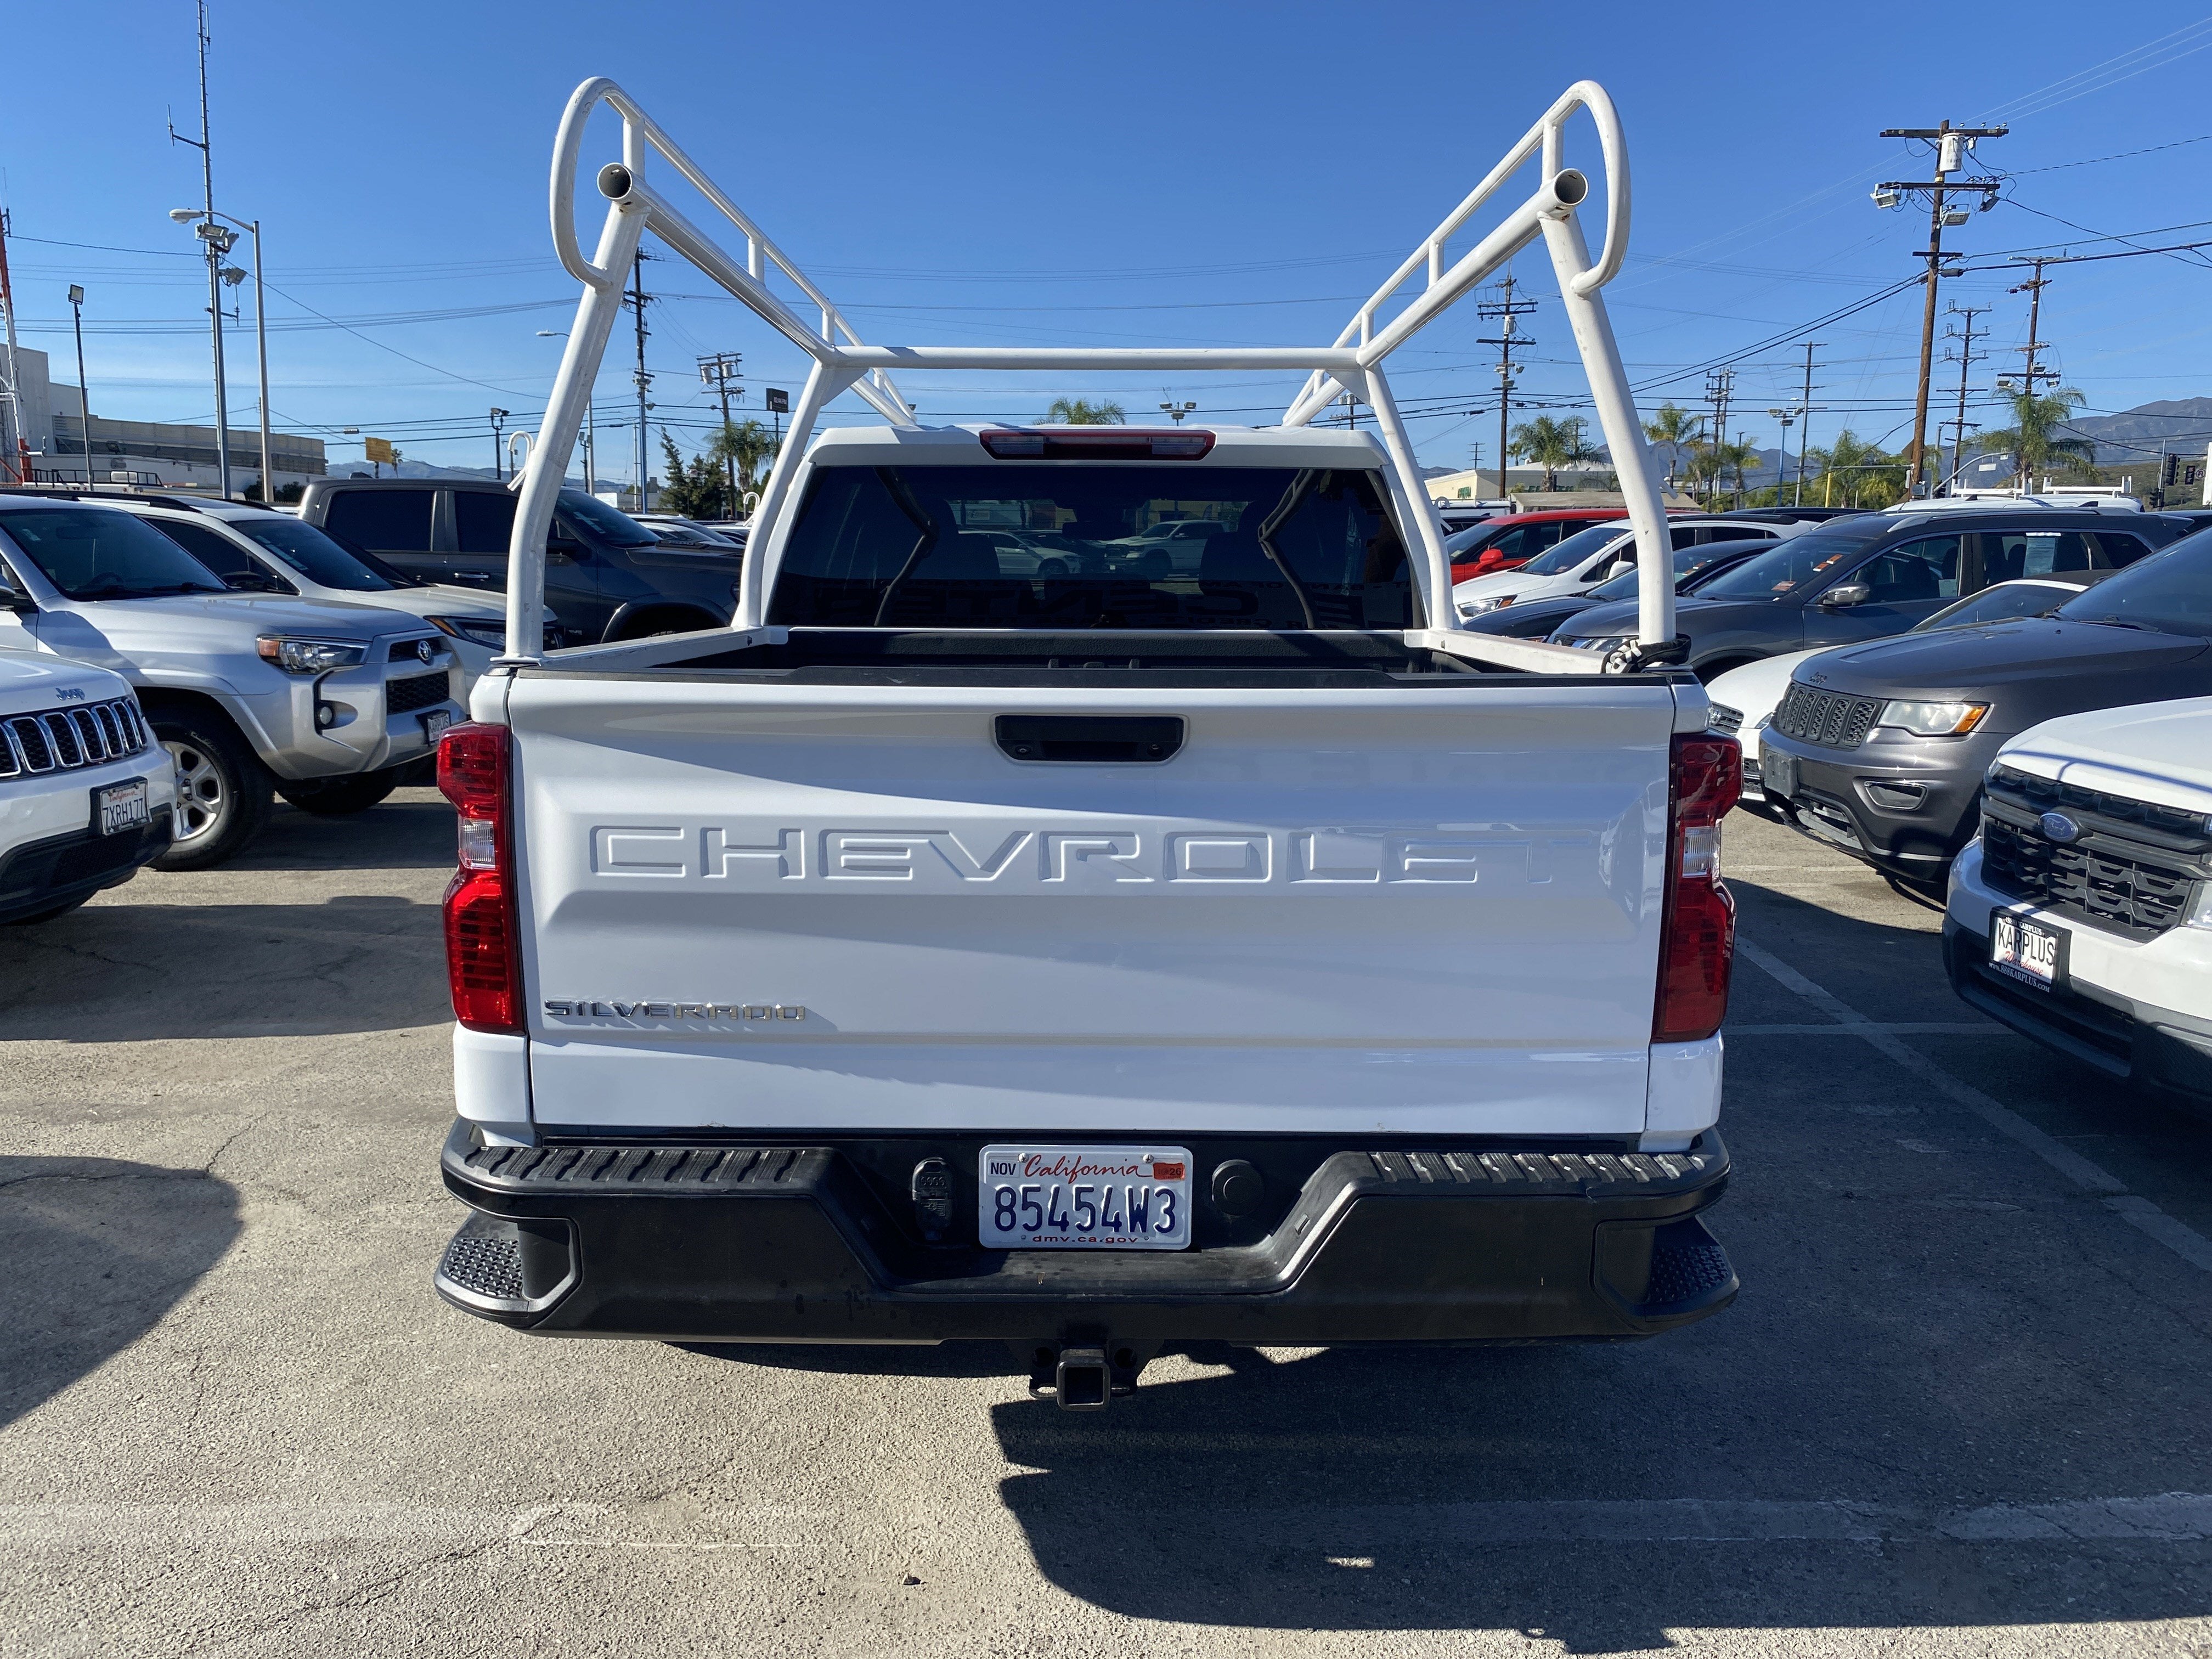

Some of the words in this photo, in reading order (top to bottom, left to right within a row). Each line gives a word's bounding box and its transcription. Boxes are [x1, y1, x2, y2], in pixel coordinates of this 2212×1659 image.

[55, 687, 85, 701] Jeep
[102, 798, 143, 826] 7XRH177
[590, 825, 1593, 884] CHEVROLET
[1998, 923, 2055, 966] KARPLUS
[2005, 951, 2044, 976] Warehouse
[544, 999, 805, 1021] SILVERADO
[990, 1162, 1016, 1176] NOV
[1024, 1154, 1153, 1184] California
[1170, 1167, 1181, 1176] 26
[994, 1186, 1176, 1233] 85454W3
[1032, 1234, 1138, 1244] dmv.ca.gov
